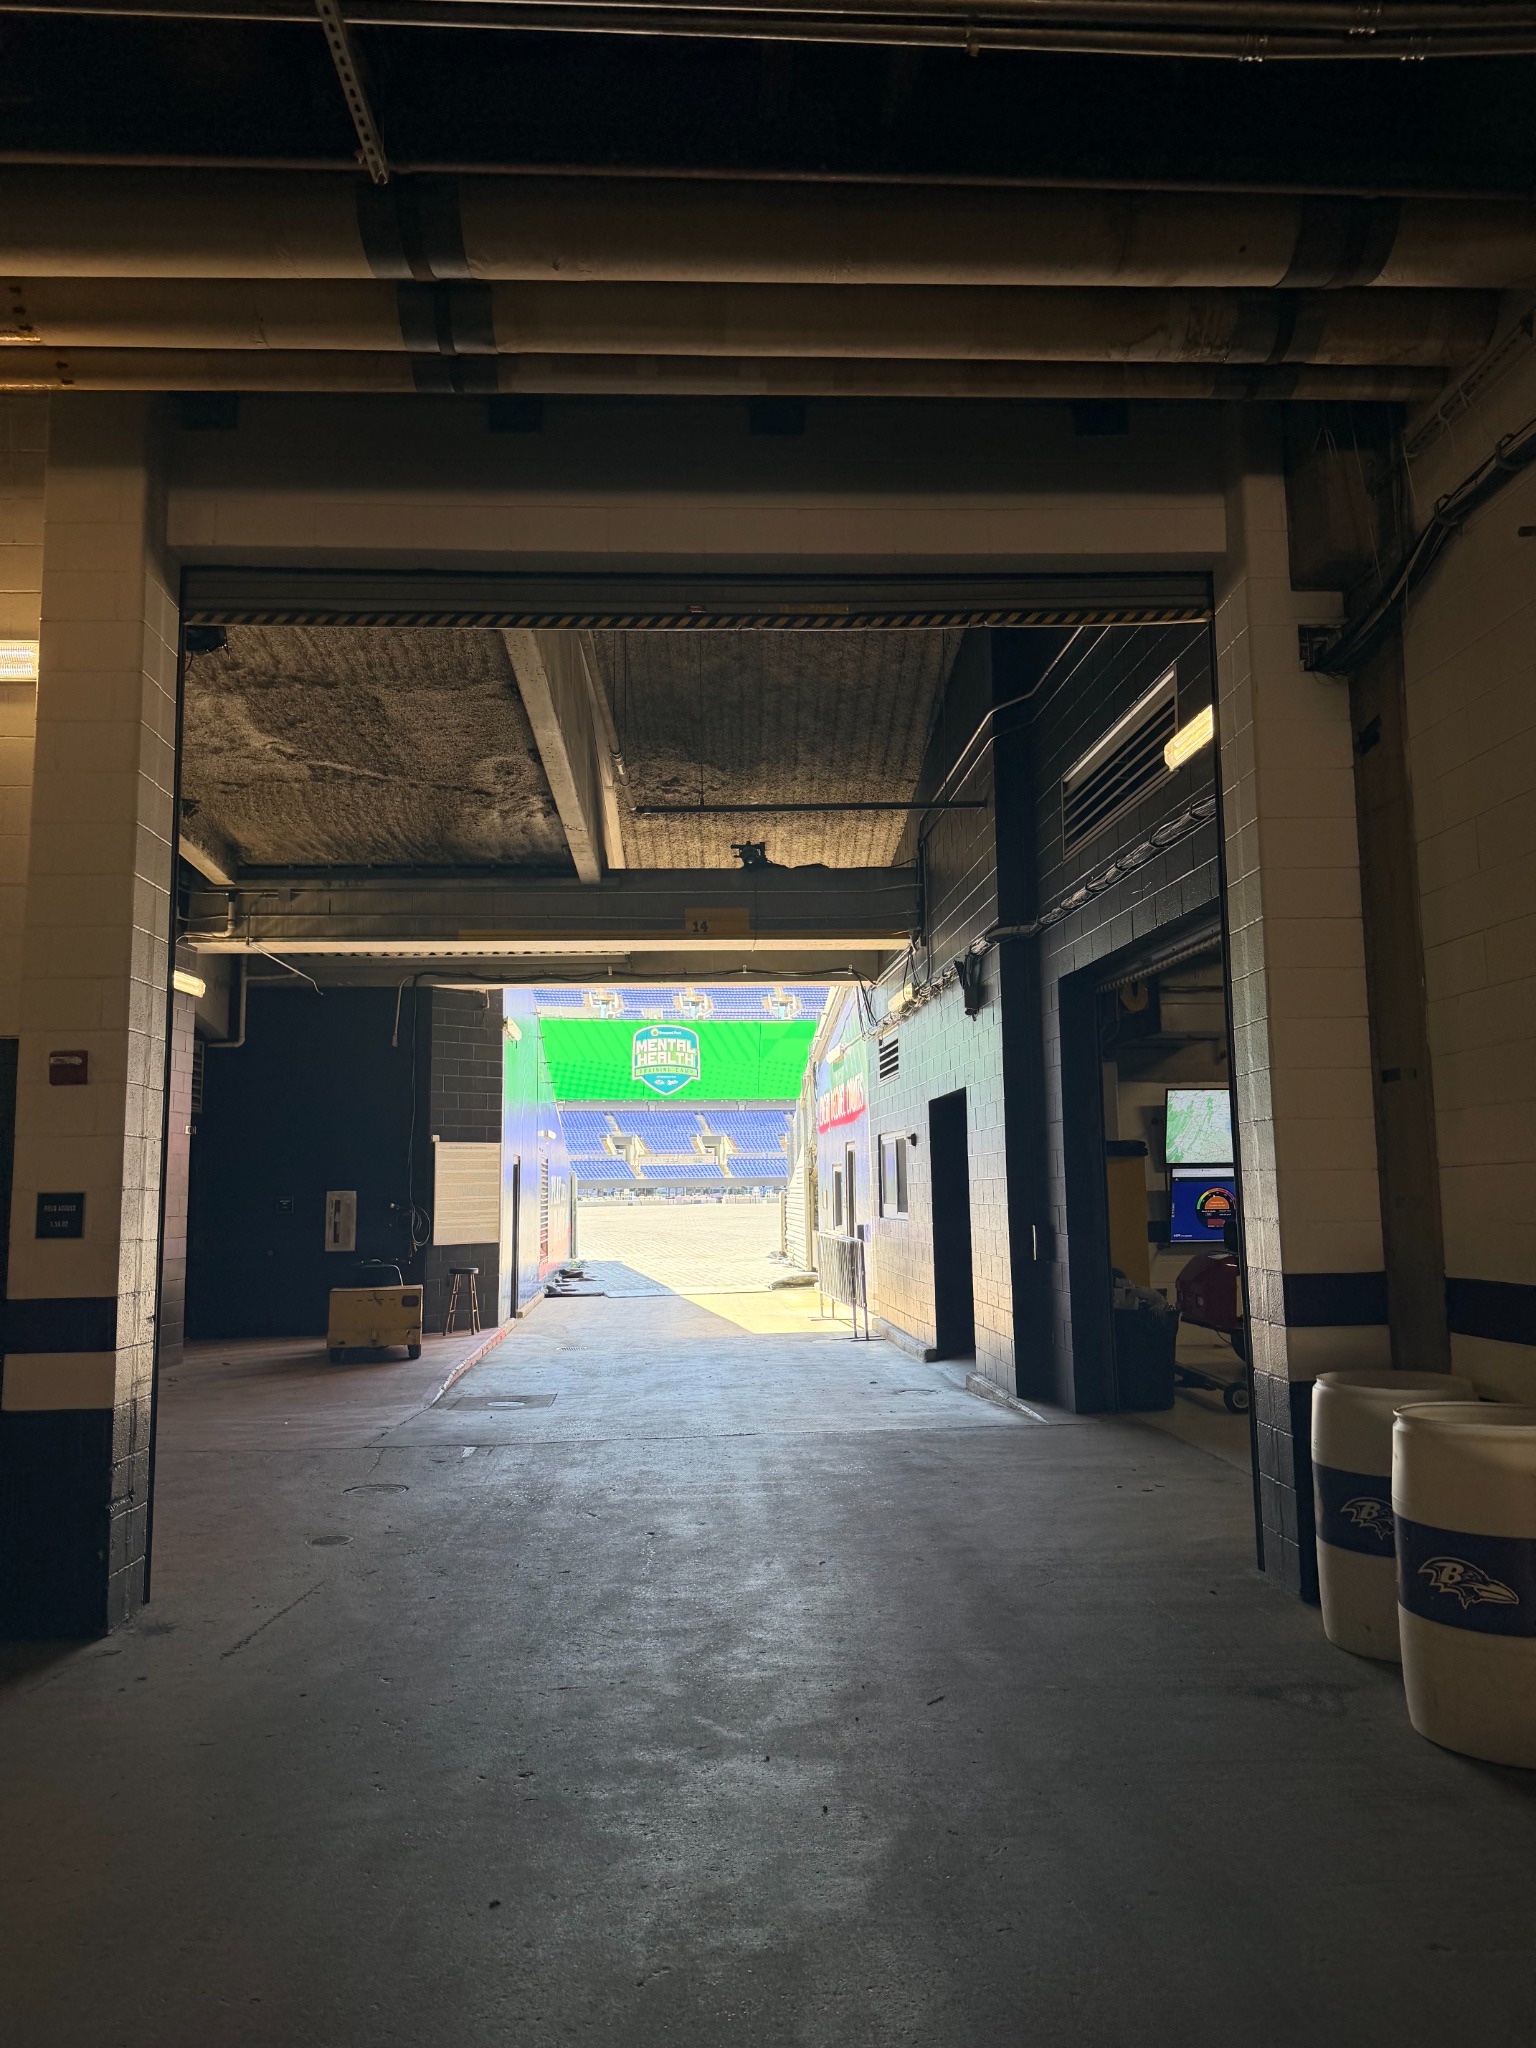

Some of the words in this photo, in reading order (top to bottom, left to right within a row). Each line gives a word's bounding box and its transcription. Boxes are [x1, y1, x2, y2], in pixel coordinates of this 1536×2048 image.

[692, 920, 709, 933] 14
[635, 1038, 697, 1054] MENTAL
[637, 1051, 695, 1067] HEALTH
